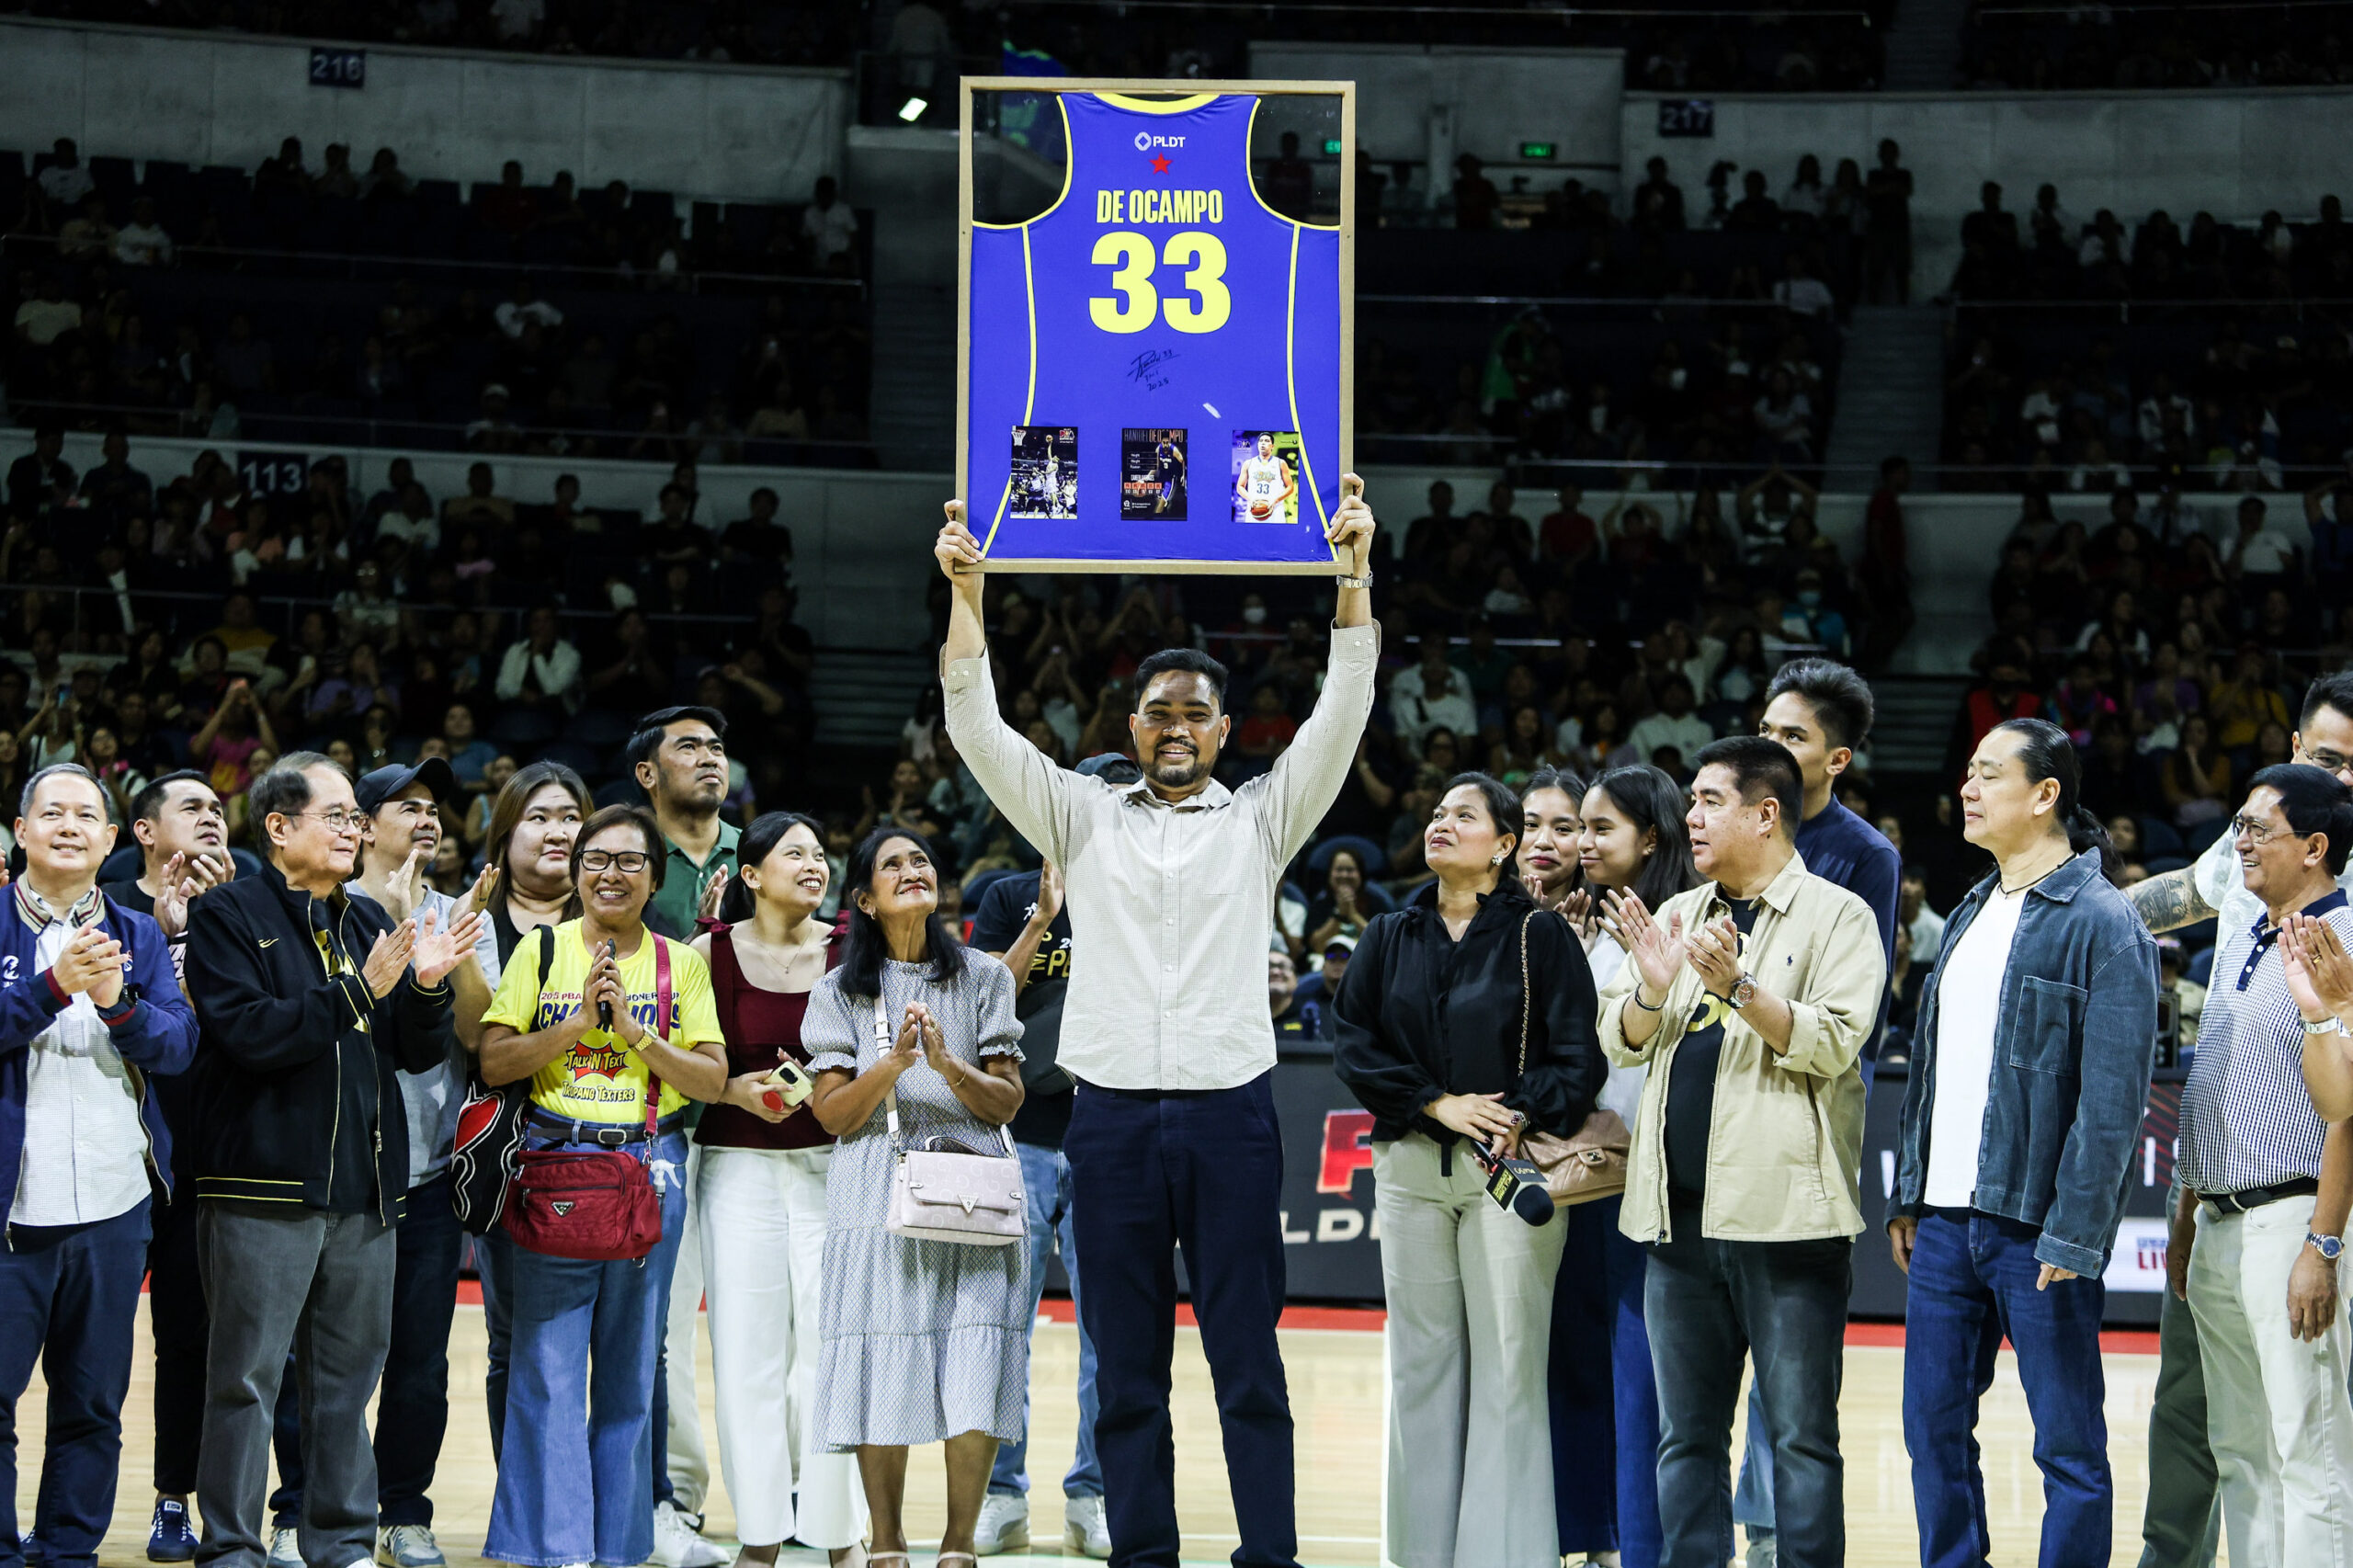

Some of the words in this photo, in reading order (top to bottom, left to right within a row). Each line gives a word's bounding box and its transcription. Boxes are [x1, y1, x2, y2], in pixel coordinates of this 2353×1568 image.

[1153, 135, 1186, 148] PLDT
[1096, 189, 1126, 223] DE
[1129, 188, 1224, 224] OCAMPO
[1088, 231, 1233, 335] 33
[243, 460, 301, 494] 113
[1256, 483, 1270, 494] 33
[562, 992, 582, 1001] PBA
[567, 1050, 589, 1071] TALK
[603, 1051, 624, 1072] TEXT
[597, 1085, 635, 1102] TEXTERS
